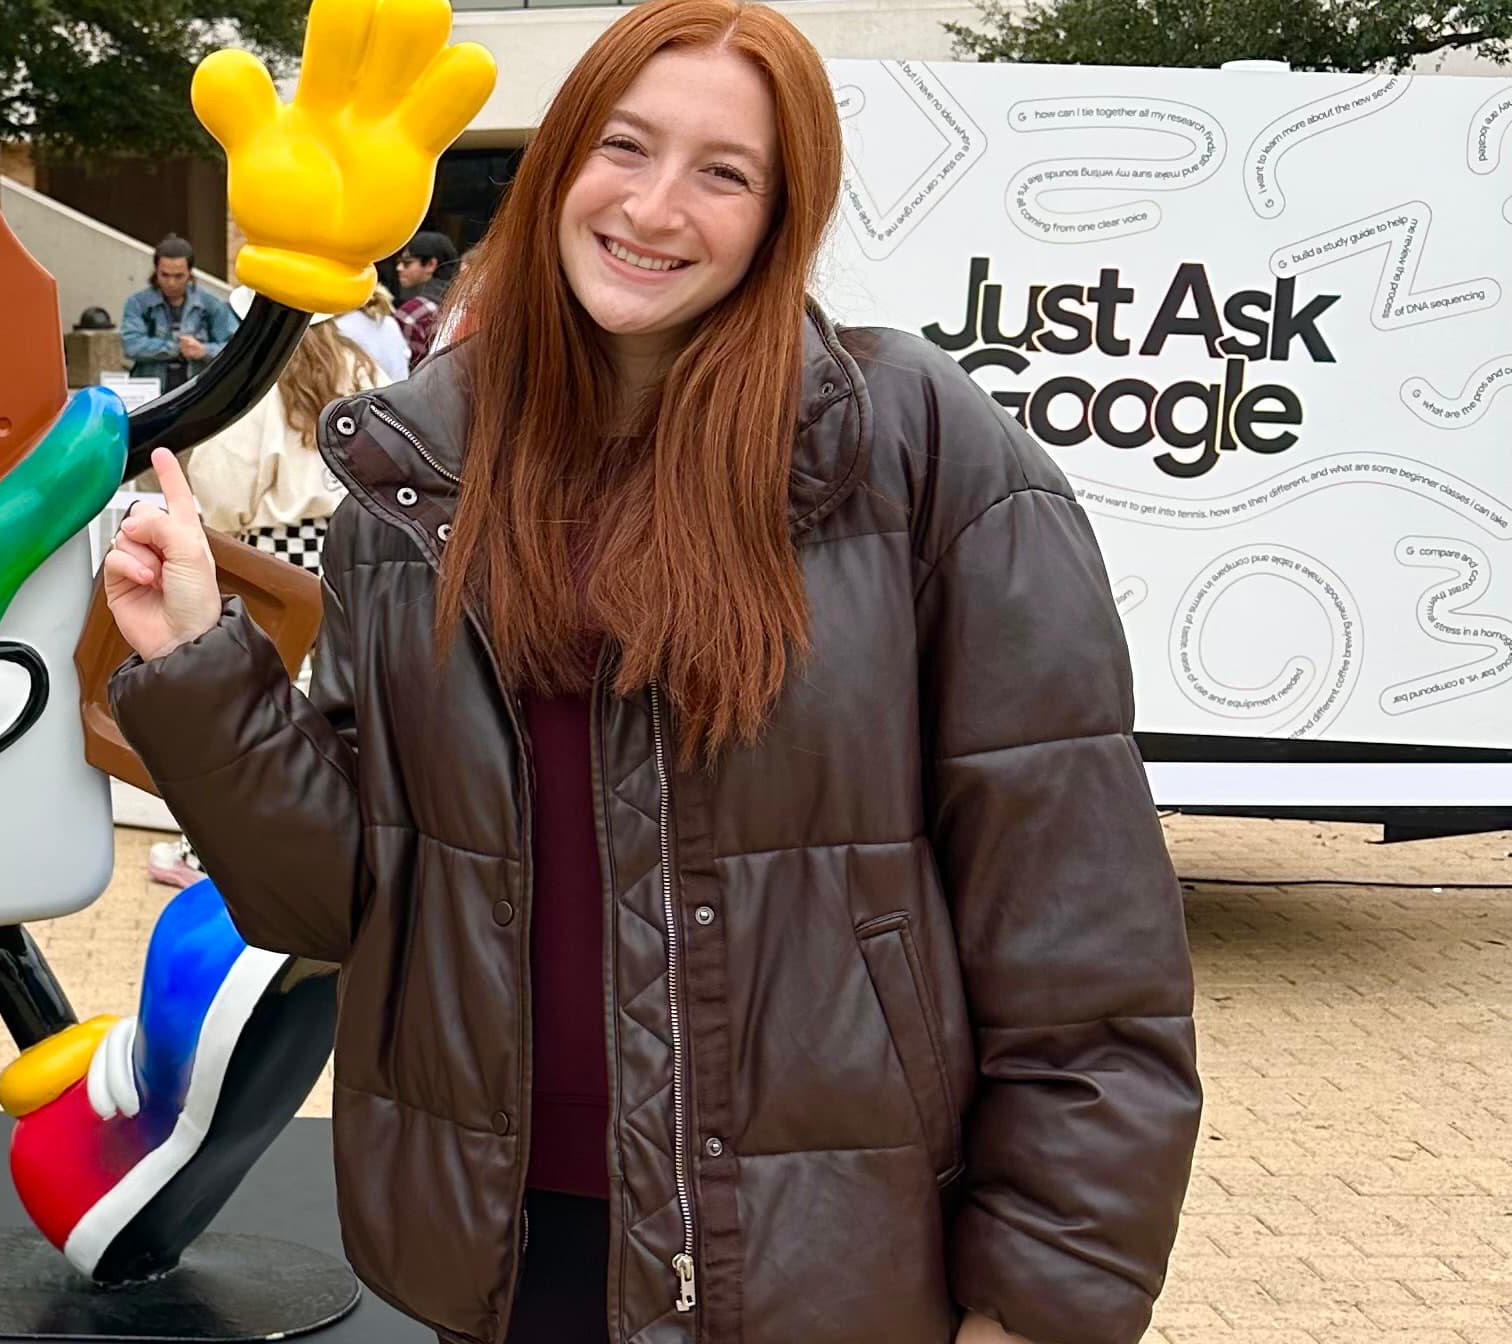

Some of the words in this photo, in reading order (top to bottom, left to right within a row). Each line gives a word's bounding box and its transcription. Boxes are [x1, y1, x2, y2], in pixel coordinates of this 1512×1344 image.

[1371, 77, 1398, 100] seven
[1334, 103, 1351, 115] the
[1351, 96, 1371, 109] new
[1018, 112, 1027, 122] G
[1034, 110, 1056, 119] how
[1057, 110, 1075, 118] can
[1096, 108, 1137, 119] together
[1138, 108, 1150, 118] all
[1151, 110, 1166, 122] my
[1307, 109, 1335, 125] about
[1485, 111, 1499, 125] are
[916, 80, 934, 100] have
[932, 98, 943, 111] no
[941, 109, 956, 126] idea
[955, 152, 965, 161] to
[1167, 114, 1205, 133] research
[1282, 119, 1306, 137] more
[1199, 131, 1216, 167] findings
[1261, 134, 1283, 154] learn
[1479, 125, 1490, 162] located
[1257, 154, 1267, 165] to
[1044, 169, 1079, 180] sounds
[1080, 168, 1113, 178] writing
[1115, 168, 1131, 178] my
[1132, 170, 1153, 178] sure
[1154, 169, 1181, 180] make
[1182, 163, 1199, 178] and
[1256, 166, 1266, 190] want
[1020, 208, 1051, 233] coming
[1097, 218, 1121, 230] clear
[1122, 212, 1148, 225] voice
[1387, 215, 1409, 229] help
[1052, 223, 1076, 233] from
[1077, 223, 1096, 232] one
[1376, 222, 1388, 233] to
[1408, 218, 1418, 234] me
[1349, 227, 1376, 245] guide
[1316, 247, 1323, 255] a
[1323, 236, 1349, 253] study
[1398, 233, 1413, 265] review
[1292, 248, 1316, 264] build
[1279, 260, 1288, 269] G
[1393, 264, 1405, 282] the
[1382, 281, 1399, 318] process
[1430, 290, 1486, 309] sequencing
[921, 257, 1135, 357] Just
[1139, 262, 1341, 363] Ask
[1394, 306, 1406, 317] of
[1406, 302, 1430, 315] DNA
[1412, 389, 1422, 398] G
[1423, 400, 1444, 417] what
[1444, 410, 1461, 419] are
[1461, 401, 1477, 416] the
[1473, 381, 1489, 402] pros
[1486, 367, 1504, 383] and
[1086, 491, 1105, 503] and
[1105, 497, 1128, 509] want
[1129, 501, 1140, 511] to
[1140, 504, 1157, 515] get
[1157, 507, 1177, 518] into
[1209, 509, 1231, 517] how
[1232, 503, 1248, 513] are
[1248, 494, 1269, 508] they
[1310, 467, 1329, 480] and
[1329, 463, 1353, 475] what
[1354, 463, 1370, 472] are
[1371, 464, 1399, 476] some
[1399, 468, 1439, 489] beginner
[1439, 484, 1471, 506] classes
[1473, 502, 1490, 516] can
[1489, 511, 1508, 529] take
[1406, 545, 1415, 555] G
[1419, 548, 1461, 559] compare
[1251, 554, 1270, 564] and
[1271, 555, 1294, 569] table
[1294, 562, 1301, 570] a
[1460, 554, 1479, 568] and
[1211, 556, 1250, 581] compare
[1301, 566, 1324, 585] make
[1204, 579, 1213, 590] in
[1448, 569, 1479, 596] contrast
[1188, 588, 1208, 614] terms
[1427, 591, 1447, 623] thermal
[1184, 613, 1194, 624] of
[1434, 622, 1461, 636] stress
[1463, 627, 1472, 636] in
[1472, 629, 1479, 637] a
[1343, 621, 1353, 658] brewing
[1180, 651, 1191, 673] ease
[1187, 673, 1198, 683] of
[1335, 659, 1350, 689] coffee
[1481, 667, 1497, 679] bar
[1277, 667, 1304, 699] needed
[1459, 677, 1465, 685] a
[1193, 682, 1209, 696] use
[1409, 679, 1458, 700] compound
[1207, 693, 1226, 706] and
[1226, 693, 1277, 710] equipment
[1393, 692, 1409, 704] bar
[1313, 688, 1340, 723] different
